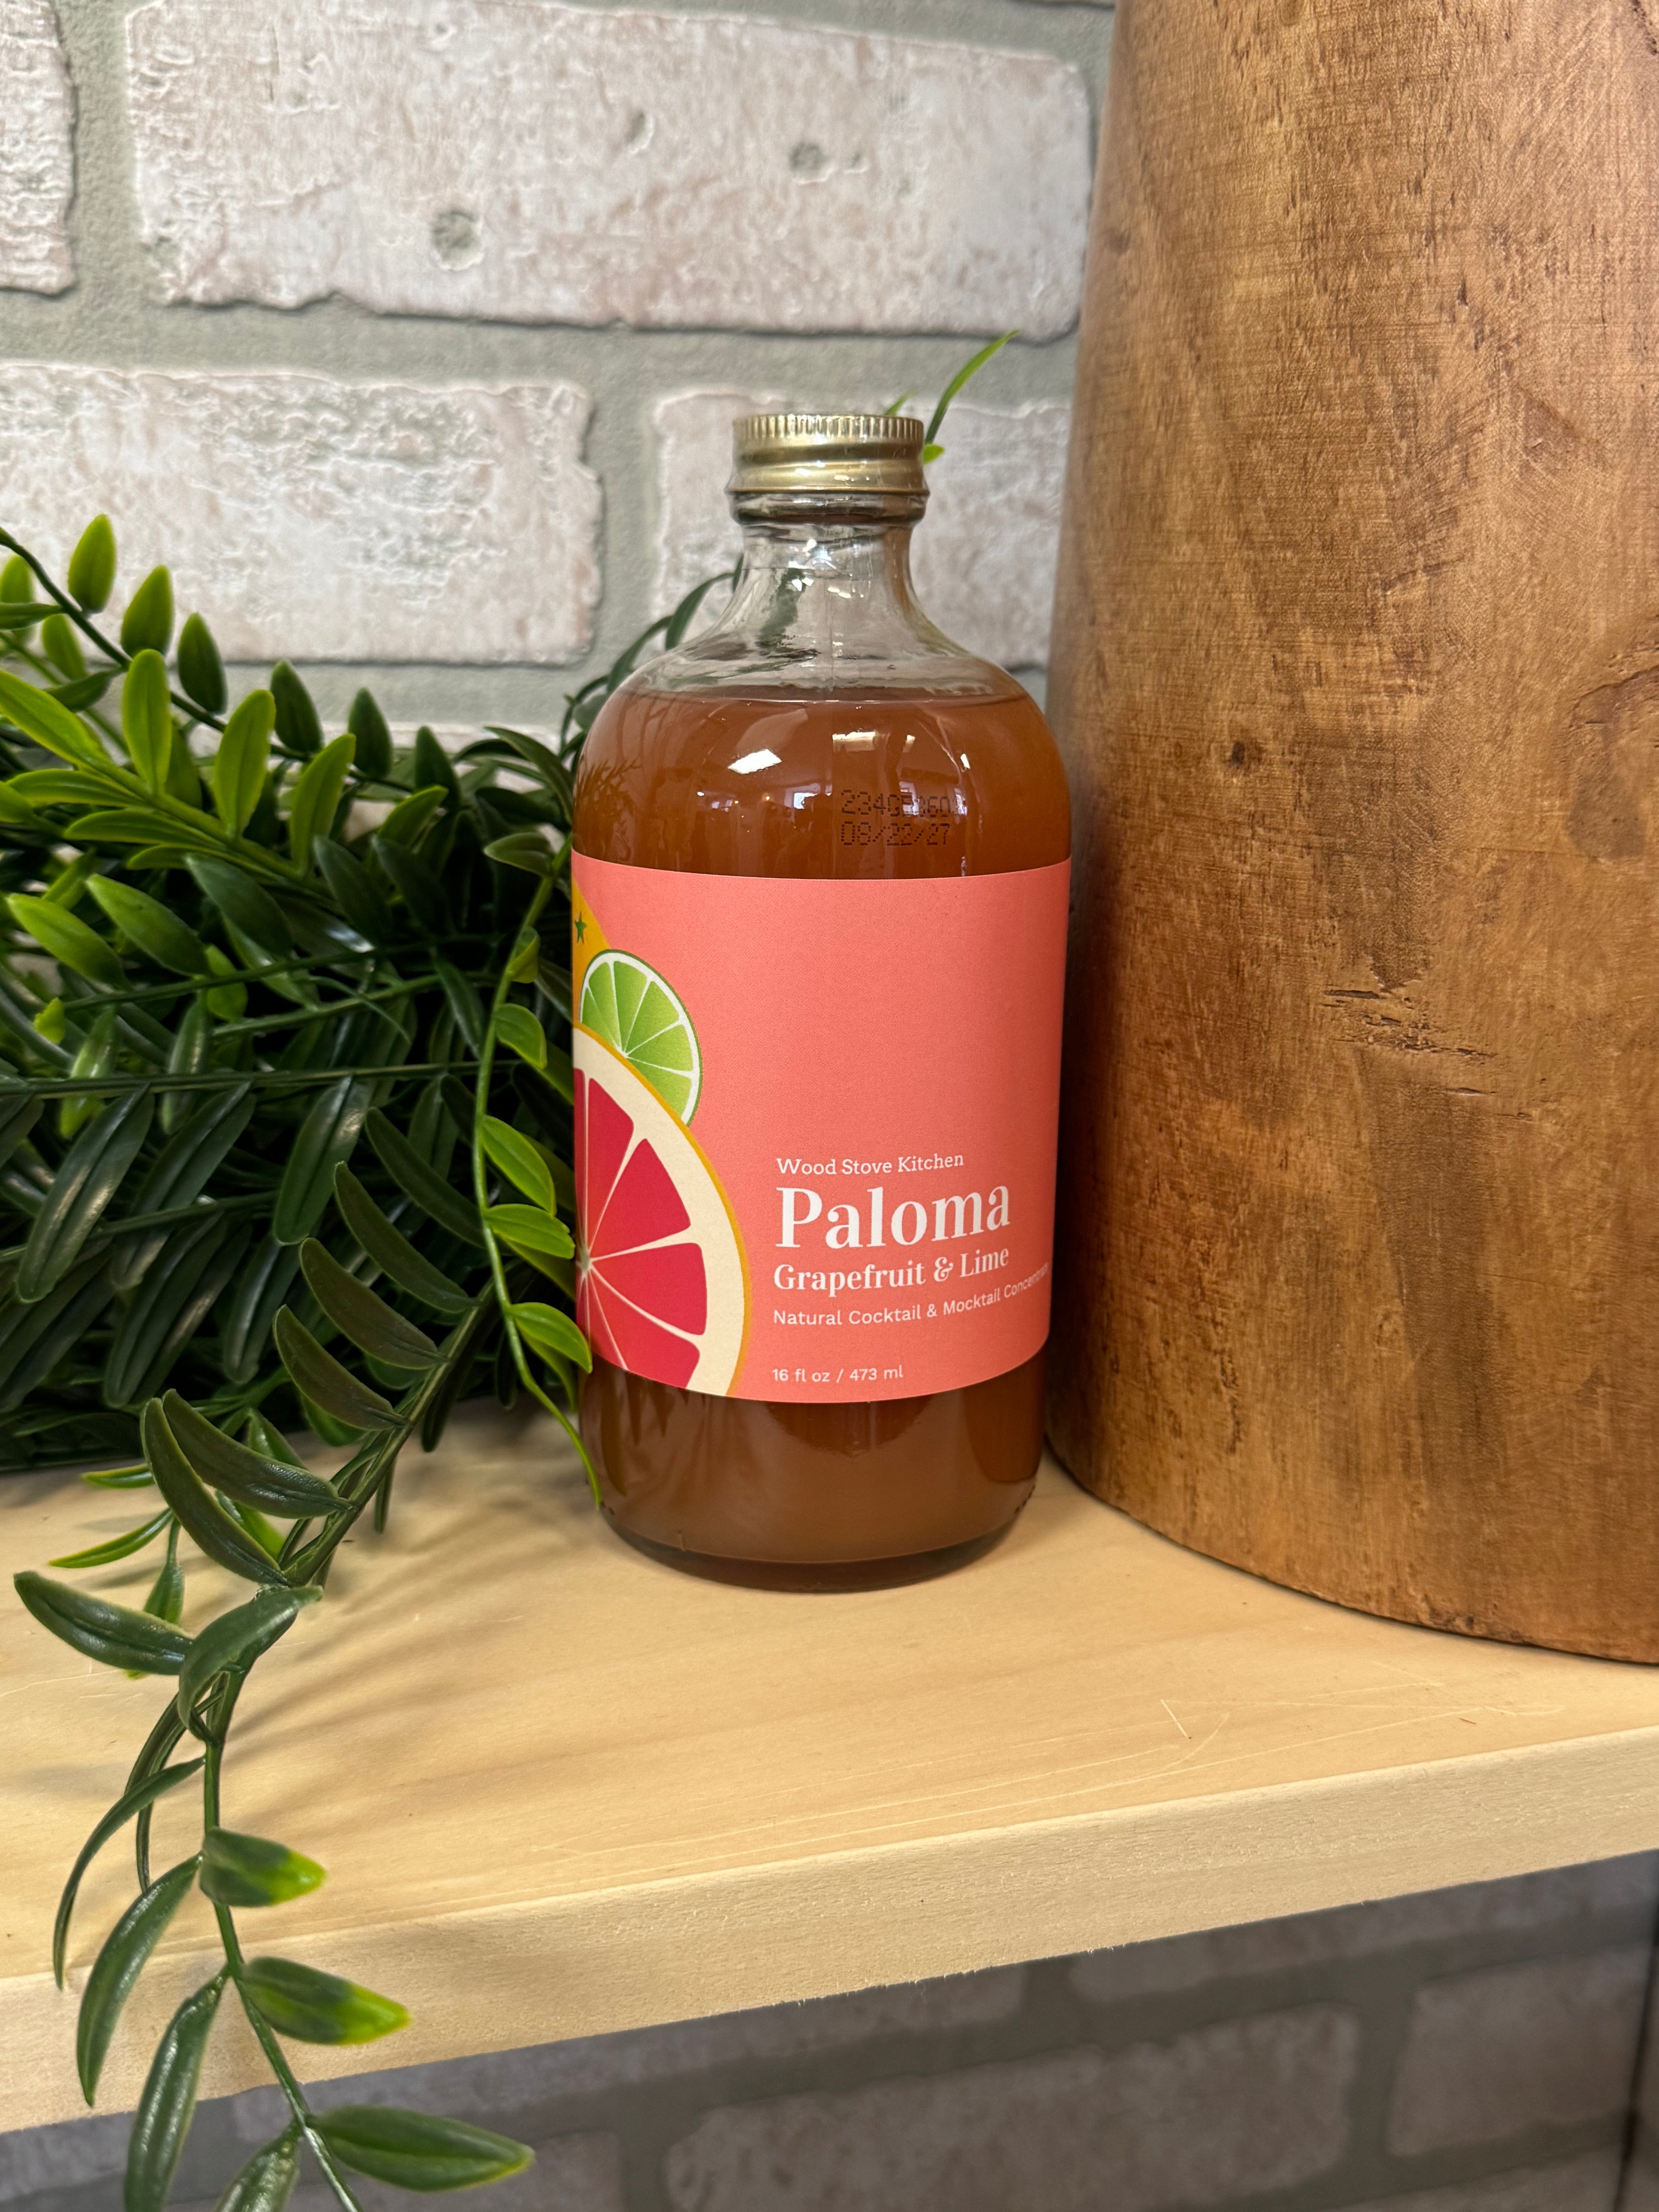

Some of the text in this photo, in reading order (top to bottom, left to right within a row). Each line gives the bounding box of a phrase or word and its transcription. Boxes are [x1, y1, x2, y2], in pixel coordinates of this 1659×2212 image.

[841, 821, 950, 846] 08/22/27
[776, 1153, 963, 1175] Wood Stove Kitchen
[775, 1185, 1010, 1250] Paloma
[774, 1248, 1009, 1297] Grapefruit & Lime
[773, 1310, 842, 1326] Natural
[848, 1304, 921, 1325] Cocktail
[926, 1304, 937, 1317] &
[943, 1287, 1001, 1315] Mocktail
[772, 1364, 903, 1383] 16 fl oz / 473 ml
